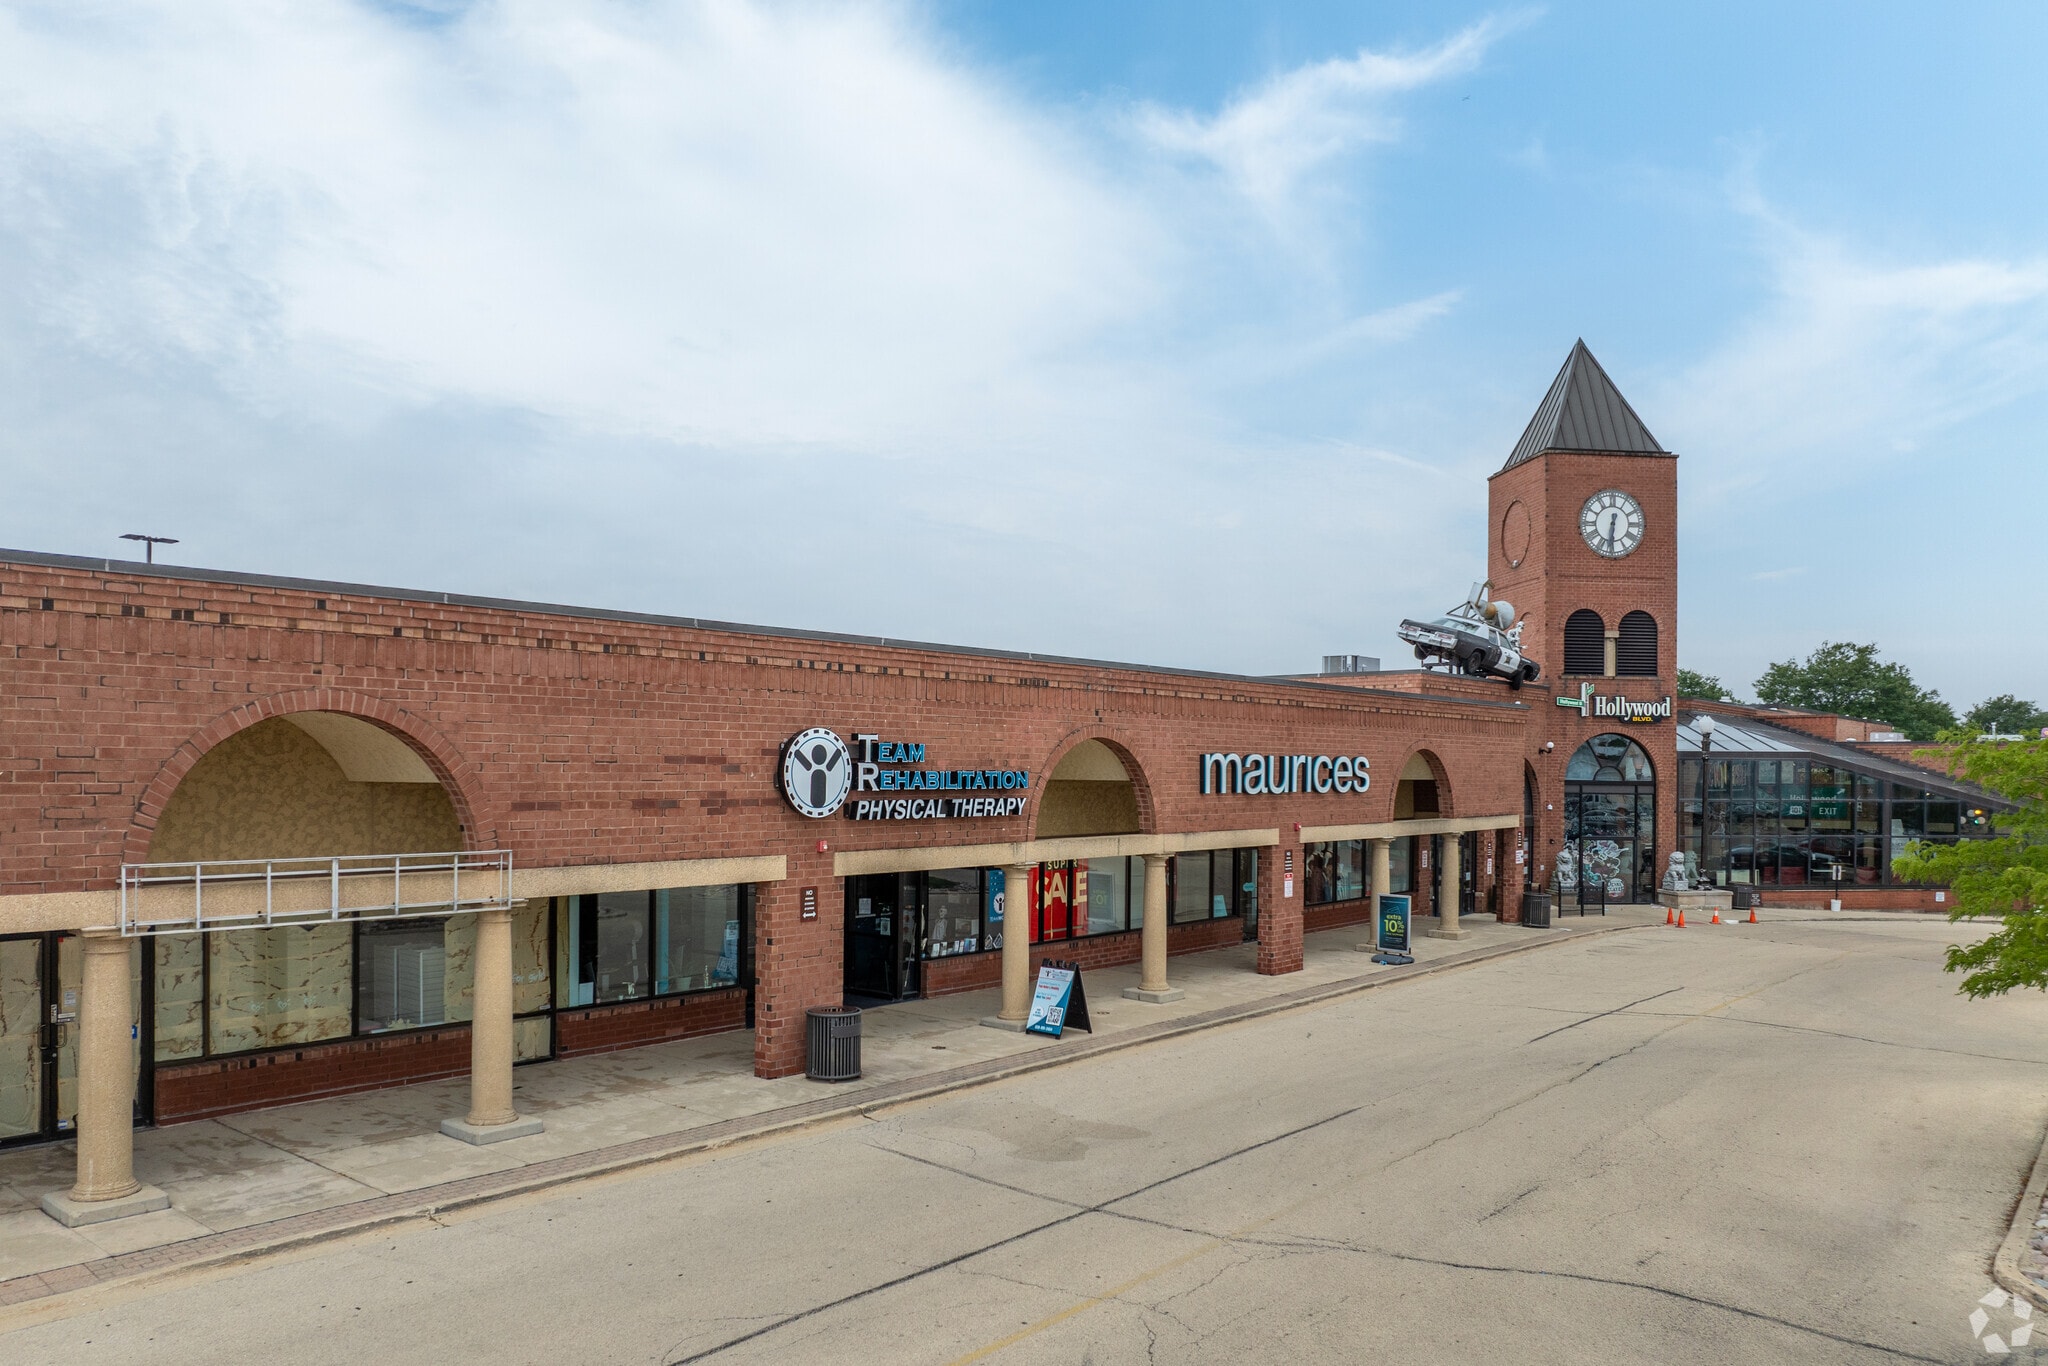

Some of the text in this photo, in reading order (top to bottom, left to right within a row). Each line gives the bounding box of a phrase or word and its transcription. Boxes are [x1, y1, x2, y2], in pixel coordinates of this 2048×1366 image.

[1595, 696, 1671, 721] Hollywood
[858, 734, 925, 763] TEAM
[858, 762, 1029, 792] REHABILITATION
[1202, 752, 1371, 795] maurices
[856, 797, 1027, 820] PHYSICAL THERAPY
[1818, 807, 1837, 815] EXIT
